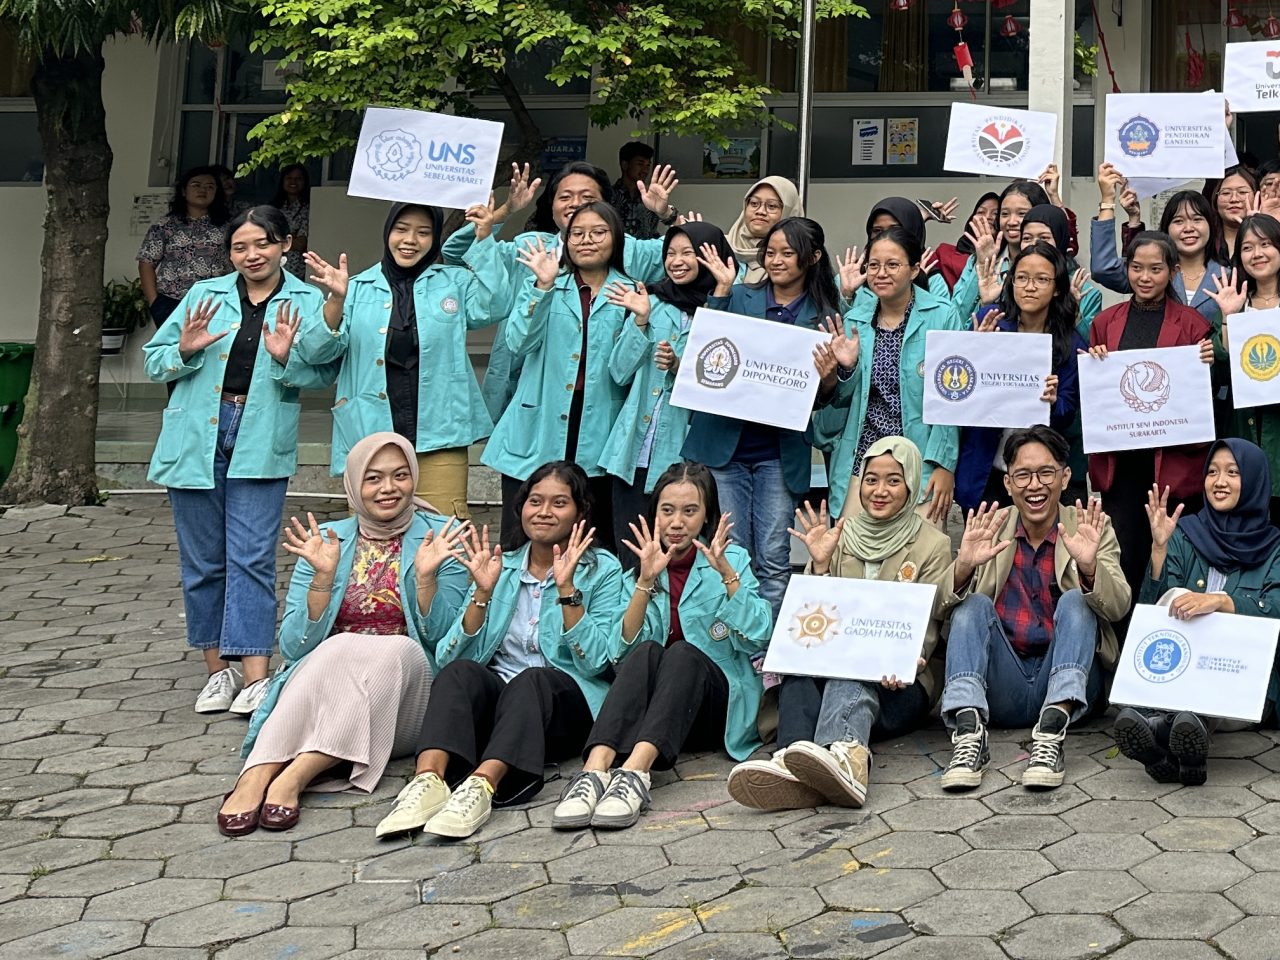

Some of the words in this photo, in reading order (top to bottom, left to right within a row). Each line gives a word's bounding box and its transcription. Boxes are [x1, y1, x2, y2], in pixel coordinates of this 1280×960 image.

[428, 140, 477, 165] UNS
[425, 163, 477, 175] UNIVERSITAS
[423, 172, 456, 182] SEBELAS
[456, 176, 484, 185] MARET
[745, 359, 811, 379] UNIVERSITAS
[742, 369, 808, 390] DIPONEGORO
[980, 372, 1040, 382] UNIVERSITAS
[1106, 422, 1135, 431] INSTITUT
[1136, 421, 1151, 429] SENI
[1152, 418, 1189, 427] INDONESIA
[1129, 429, 1167, 438] SURAKARTA
[851, 617, 912, 631] UNIVERSITAS
[844, 626, 883, 638] GADJAH
[884, 630, 913, 640] MADA
